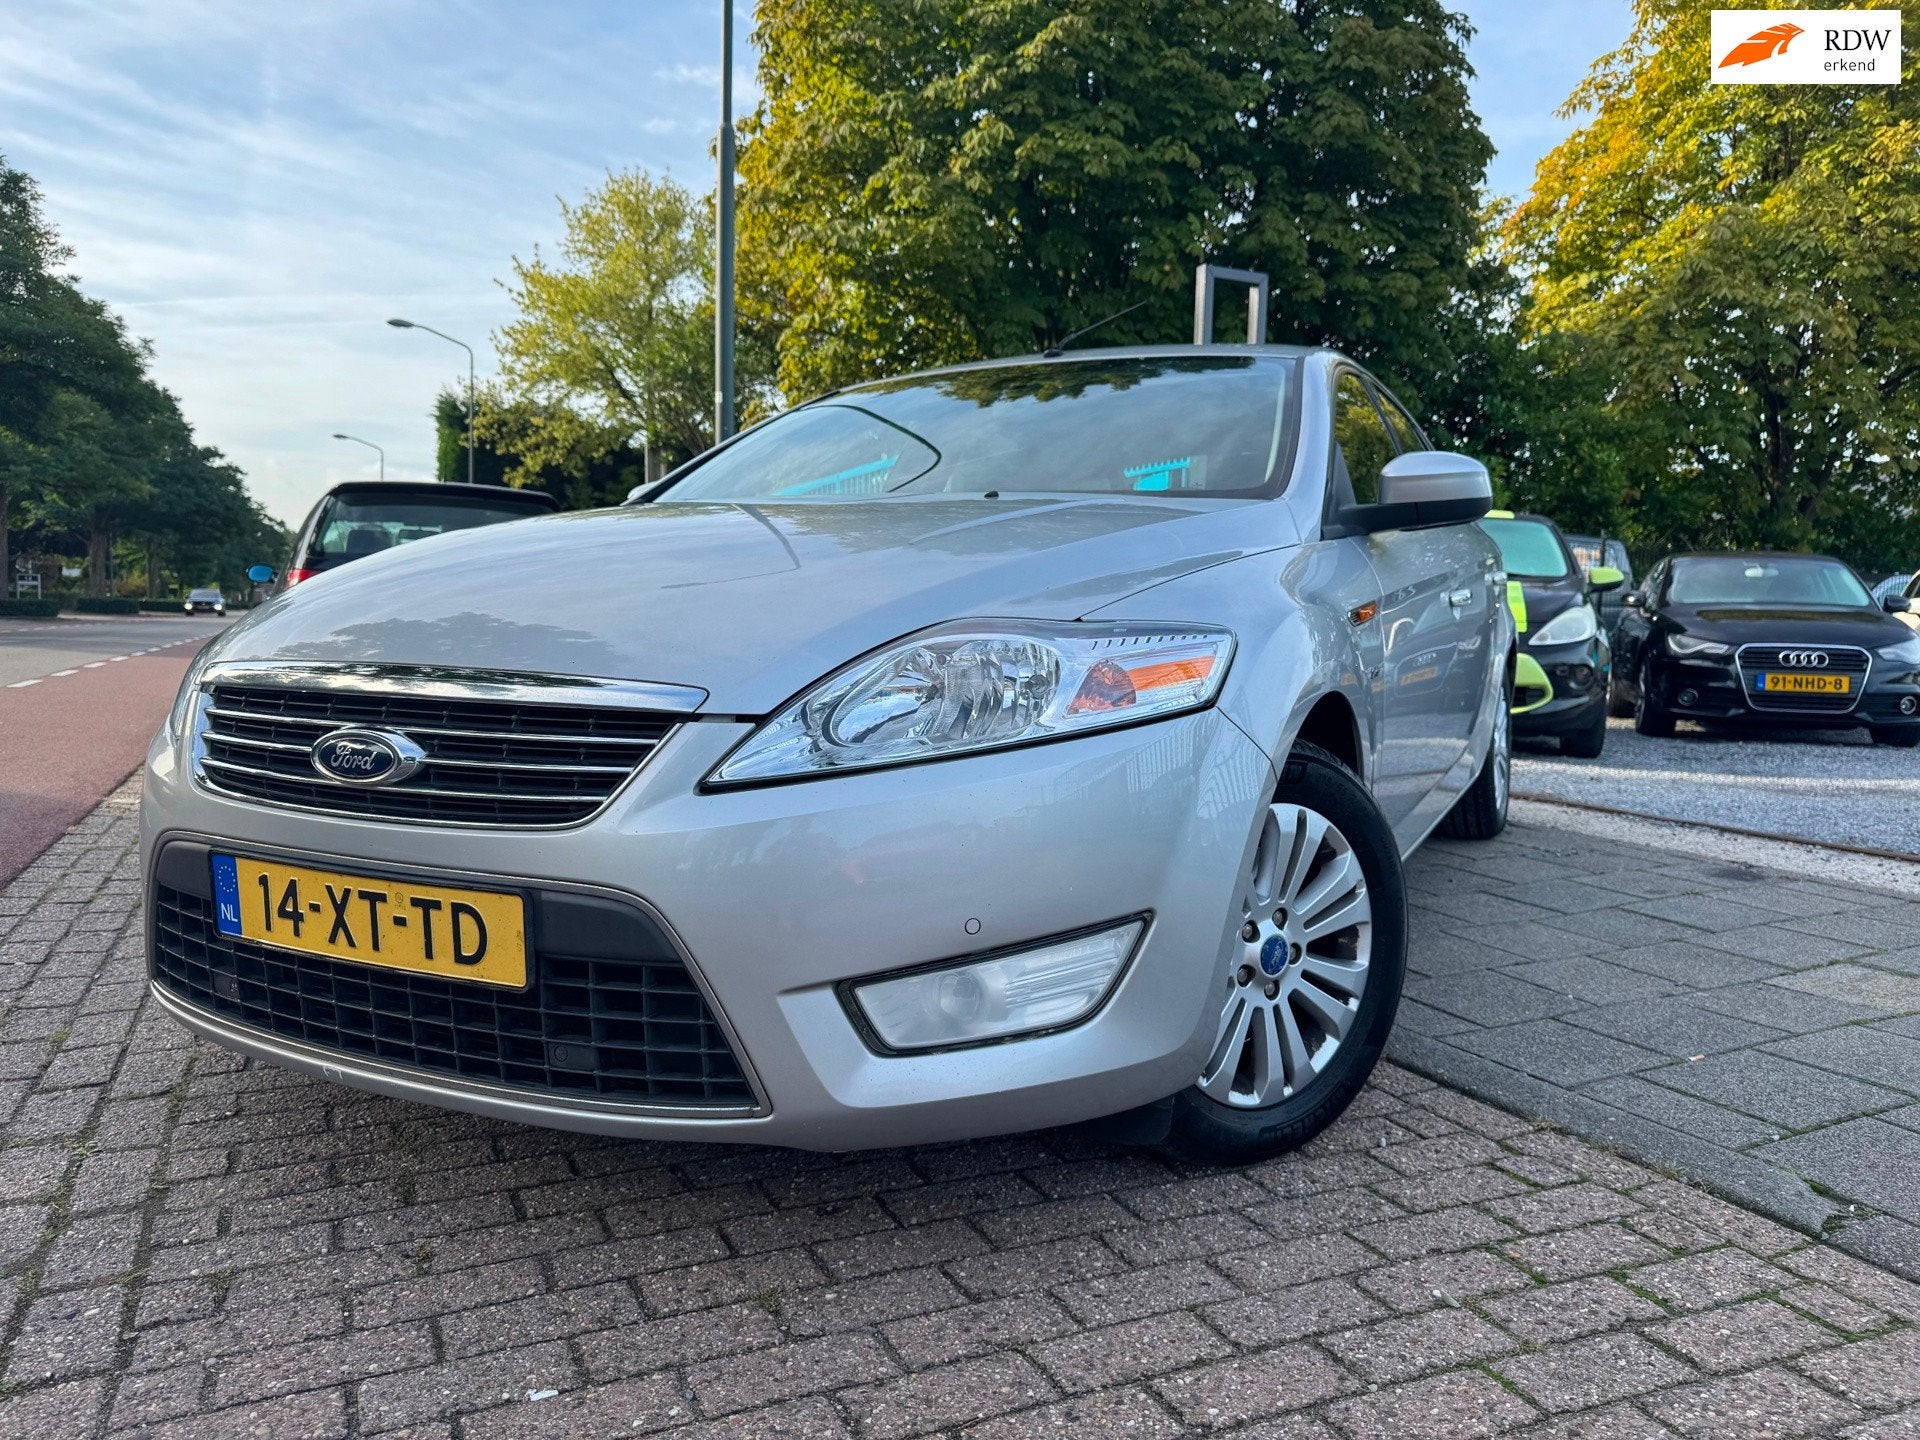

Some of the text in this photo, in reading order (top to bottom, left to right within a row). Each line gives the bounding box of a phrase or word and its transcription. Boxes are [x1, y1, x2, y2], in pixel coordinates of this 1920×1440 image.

[1771, 675, 1843, 691] 91-NHD-8
[330, 741, 378, 770] Ford
[220, 902, 239, 923] NL
[258, 873, 488, 965] 14-XT-TD
